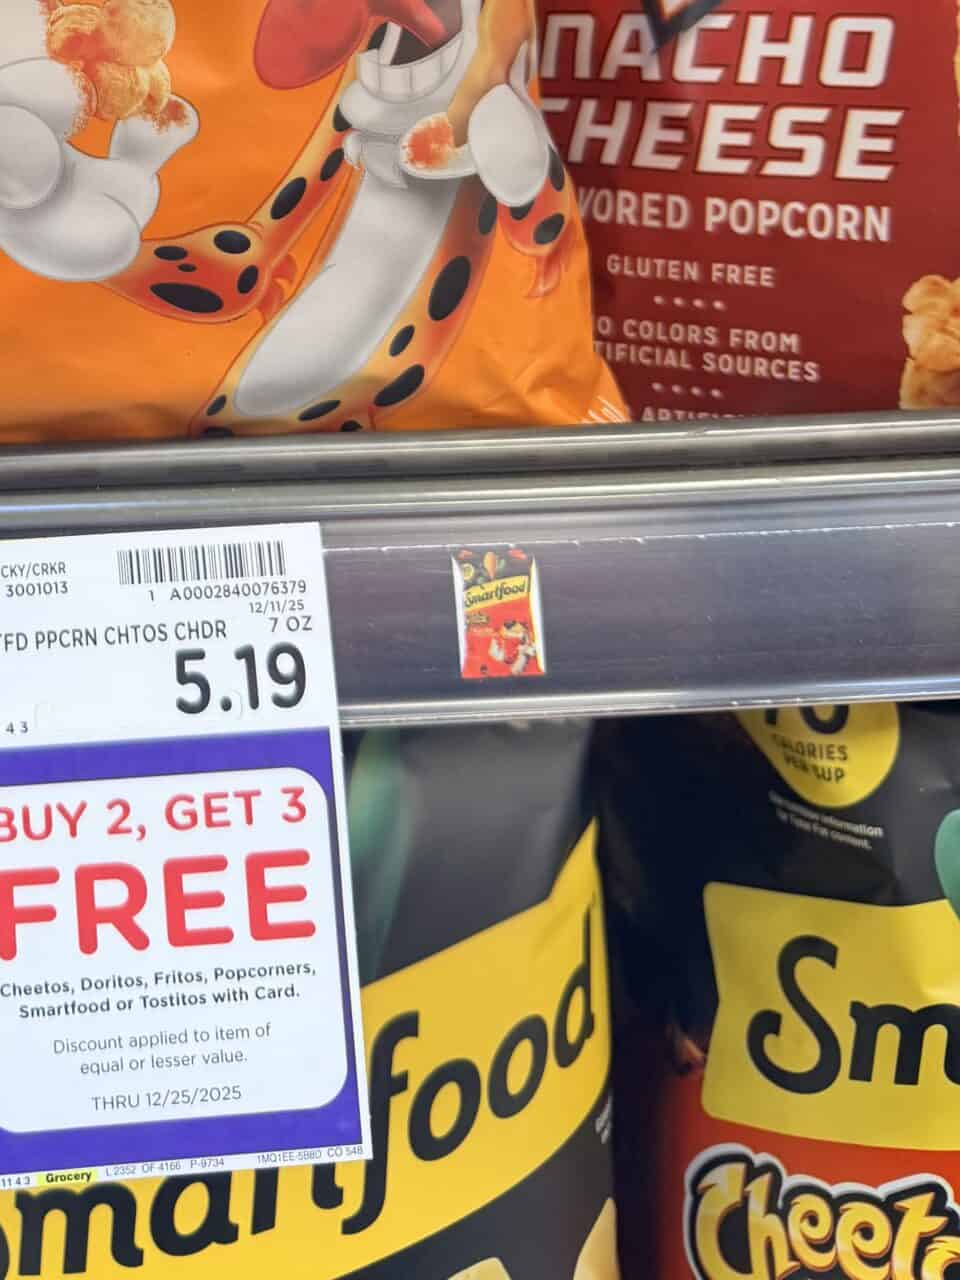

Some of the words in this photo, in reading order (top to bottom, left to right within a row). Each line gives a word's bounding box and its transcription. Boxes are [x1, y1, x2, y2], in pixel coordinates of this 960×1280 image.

[541, 14, 895, 88] NACHO
[704, 199, 892, 243] POPCORN
[606, 253, 700, 282] GLUTEN
[711, 262, 776, 288] FREE
[622, 318, 720, 347] COLORS
[728, 328, 800, 354] FROM
[701, 351, 821, 383] SOURCES
[0, 561, 67, 579] CKY/CRKR
[5, 580, 69, 598] 3001013
[148, 589, 155, 602] 1
[170, 579, 307, 601] A0002840076379
[464, 581, 526, 608] Smartfood
[249, 598, 305, 616] 12/11/25
[35, 626, 98, 650] PPCRN
[104, 623, 168, 646] CHTOS
[174, 619, 227, 641] CHDR
[268, 616, 279, 633] 7
[285, 615, 313, 632] OZ
[175, 641, 307, 715] 5.19
[6, 722, 16, 735] 4
[19, 720, 29, 734] 3
[106, 797, 147, 841] 2,
[164, 789, 262, 831] GET
[281, 786, 307, 823] 3
[0, 980, 75, 998] Cheetos,
[80, 974, 149, 992] Doritos,
[153, 969, 208, 986] Fritos,
[214, 961, 317, 982] Popcorners,
[18, 997, 111, 1019] Smartfood
[116, 999, 134, 1011] or
[139, 990, 207, 1010] Tostitos
[212, 986, 250, 1004] with
[254, 983, 301, 1000] Card.
[53, 1034, 124, 1055] Discount
[128, 1028, 189, 1051] applied
[193, 1028, 210, 1043] to
[214, 1024, 250, 1041] item
[255, 1022, 272, 1038] of
[80, 1057, 124, 1076] equal
[128, 1057, 145, 1070] or
[151, 1051, 197, 1068] lesser
[202, 1049, 248, 1065] value.
[91, 1094, 141, 1112] THRU
[145, 1085, 242, 1108] 12/25/2025
[326, 1147, 343, 1158] CO
[15, 1177, 23, 1187] 4
[24, 1176, 31, 1186] 3
[45, 1170, 93, 1183] Grocery
